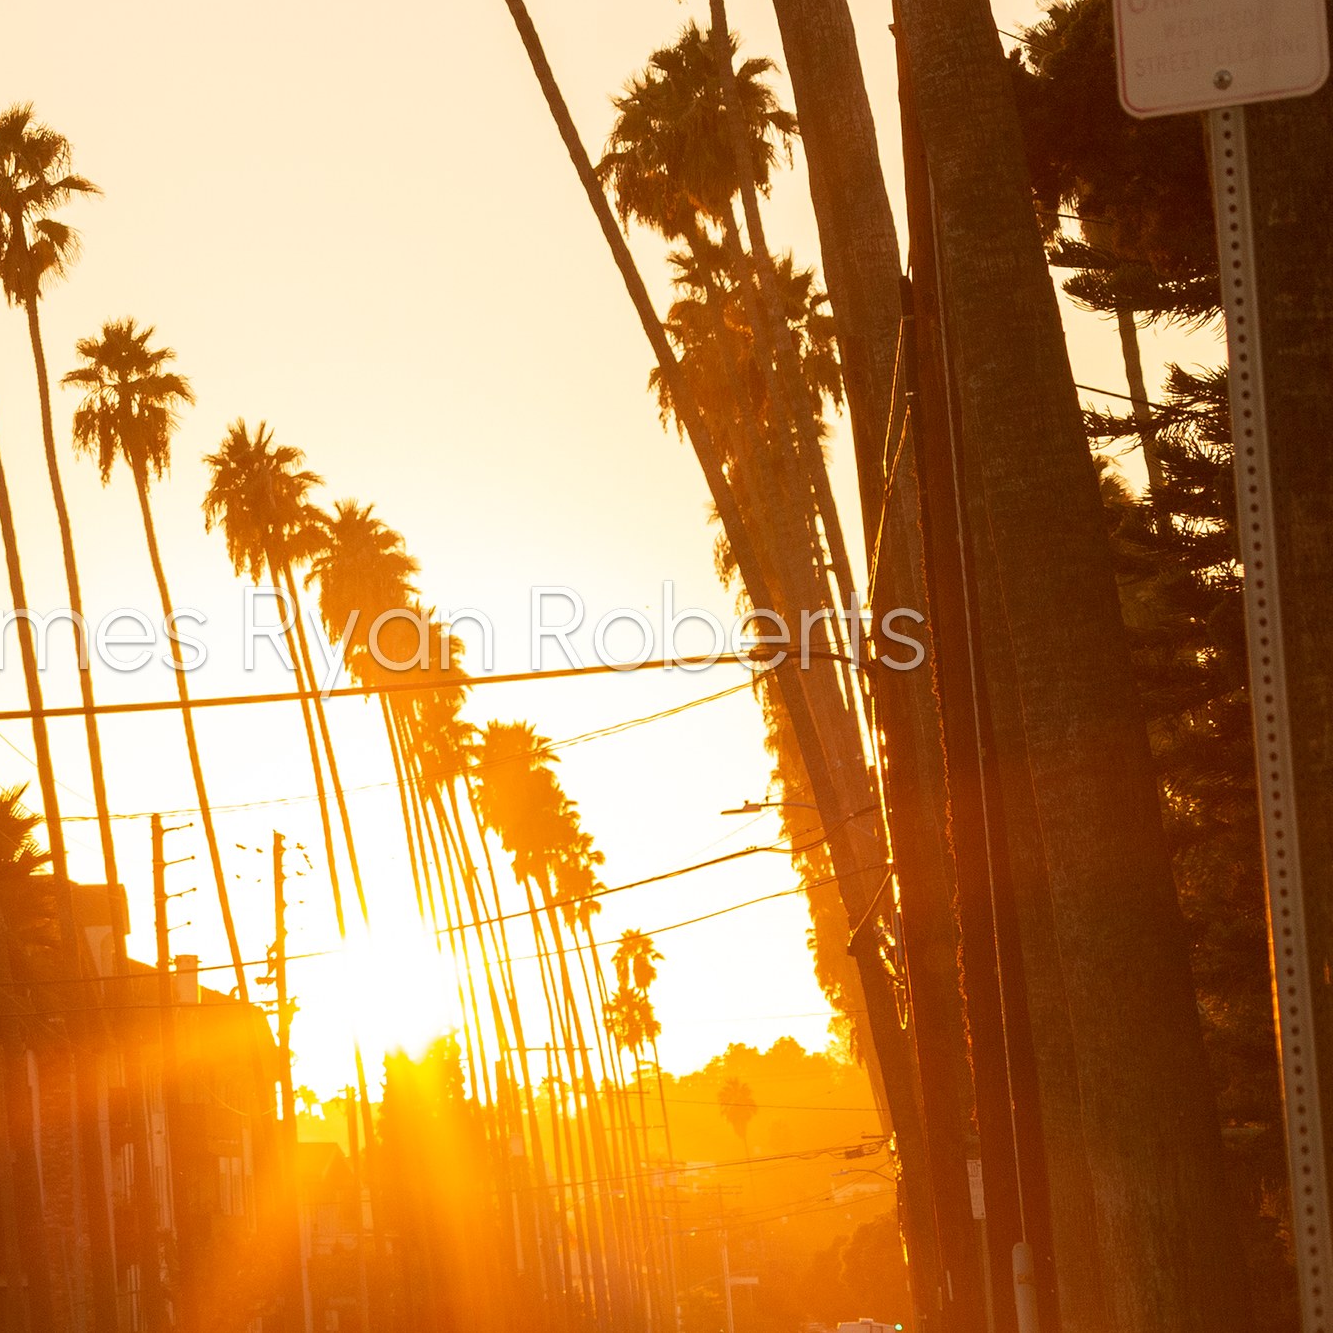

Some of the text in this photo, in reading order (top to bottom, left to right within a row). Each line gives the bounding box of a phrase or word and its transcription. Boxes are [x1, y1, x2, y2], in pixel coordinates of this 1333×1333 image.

[1162, 6, 1276, 40] WEDNESDAY
[1135, 33, 1308, 78] STREET CLEANING
